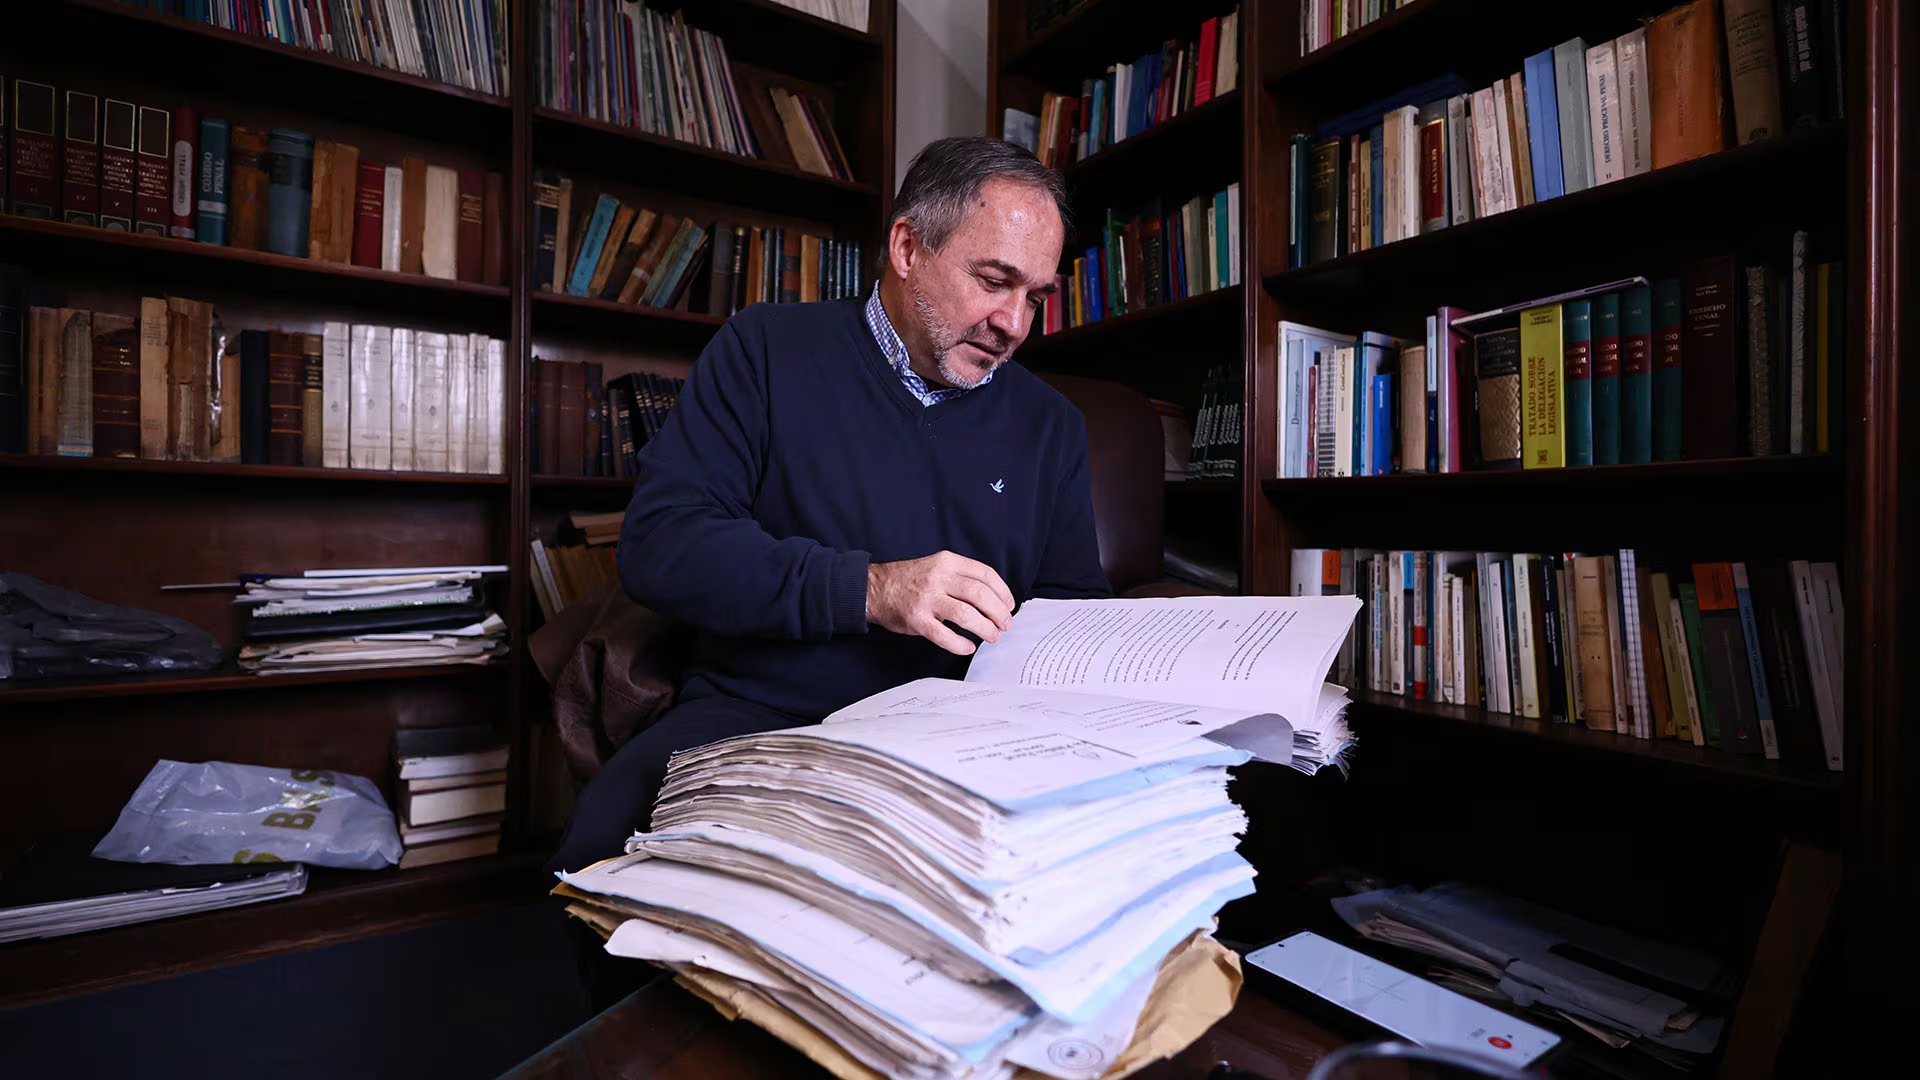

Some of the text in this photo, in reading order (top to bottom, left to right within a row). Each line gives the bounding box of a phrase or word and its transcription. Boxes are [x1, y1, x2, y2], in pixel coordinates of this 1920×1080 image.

[213, 158, 225, 195] PENAL
[1527, 356, 1537, 437] TRATADO SOBRE
[1547, 370, 1556, 435] LEGISLATIVA
[1537, 422, 1546, 436] LA
